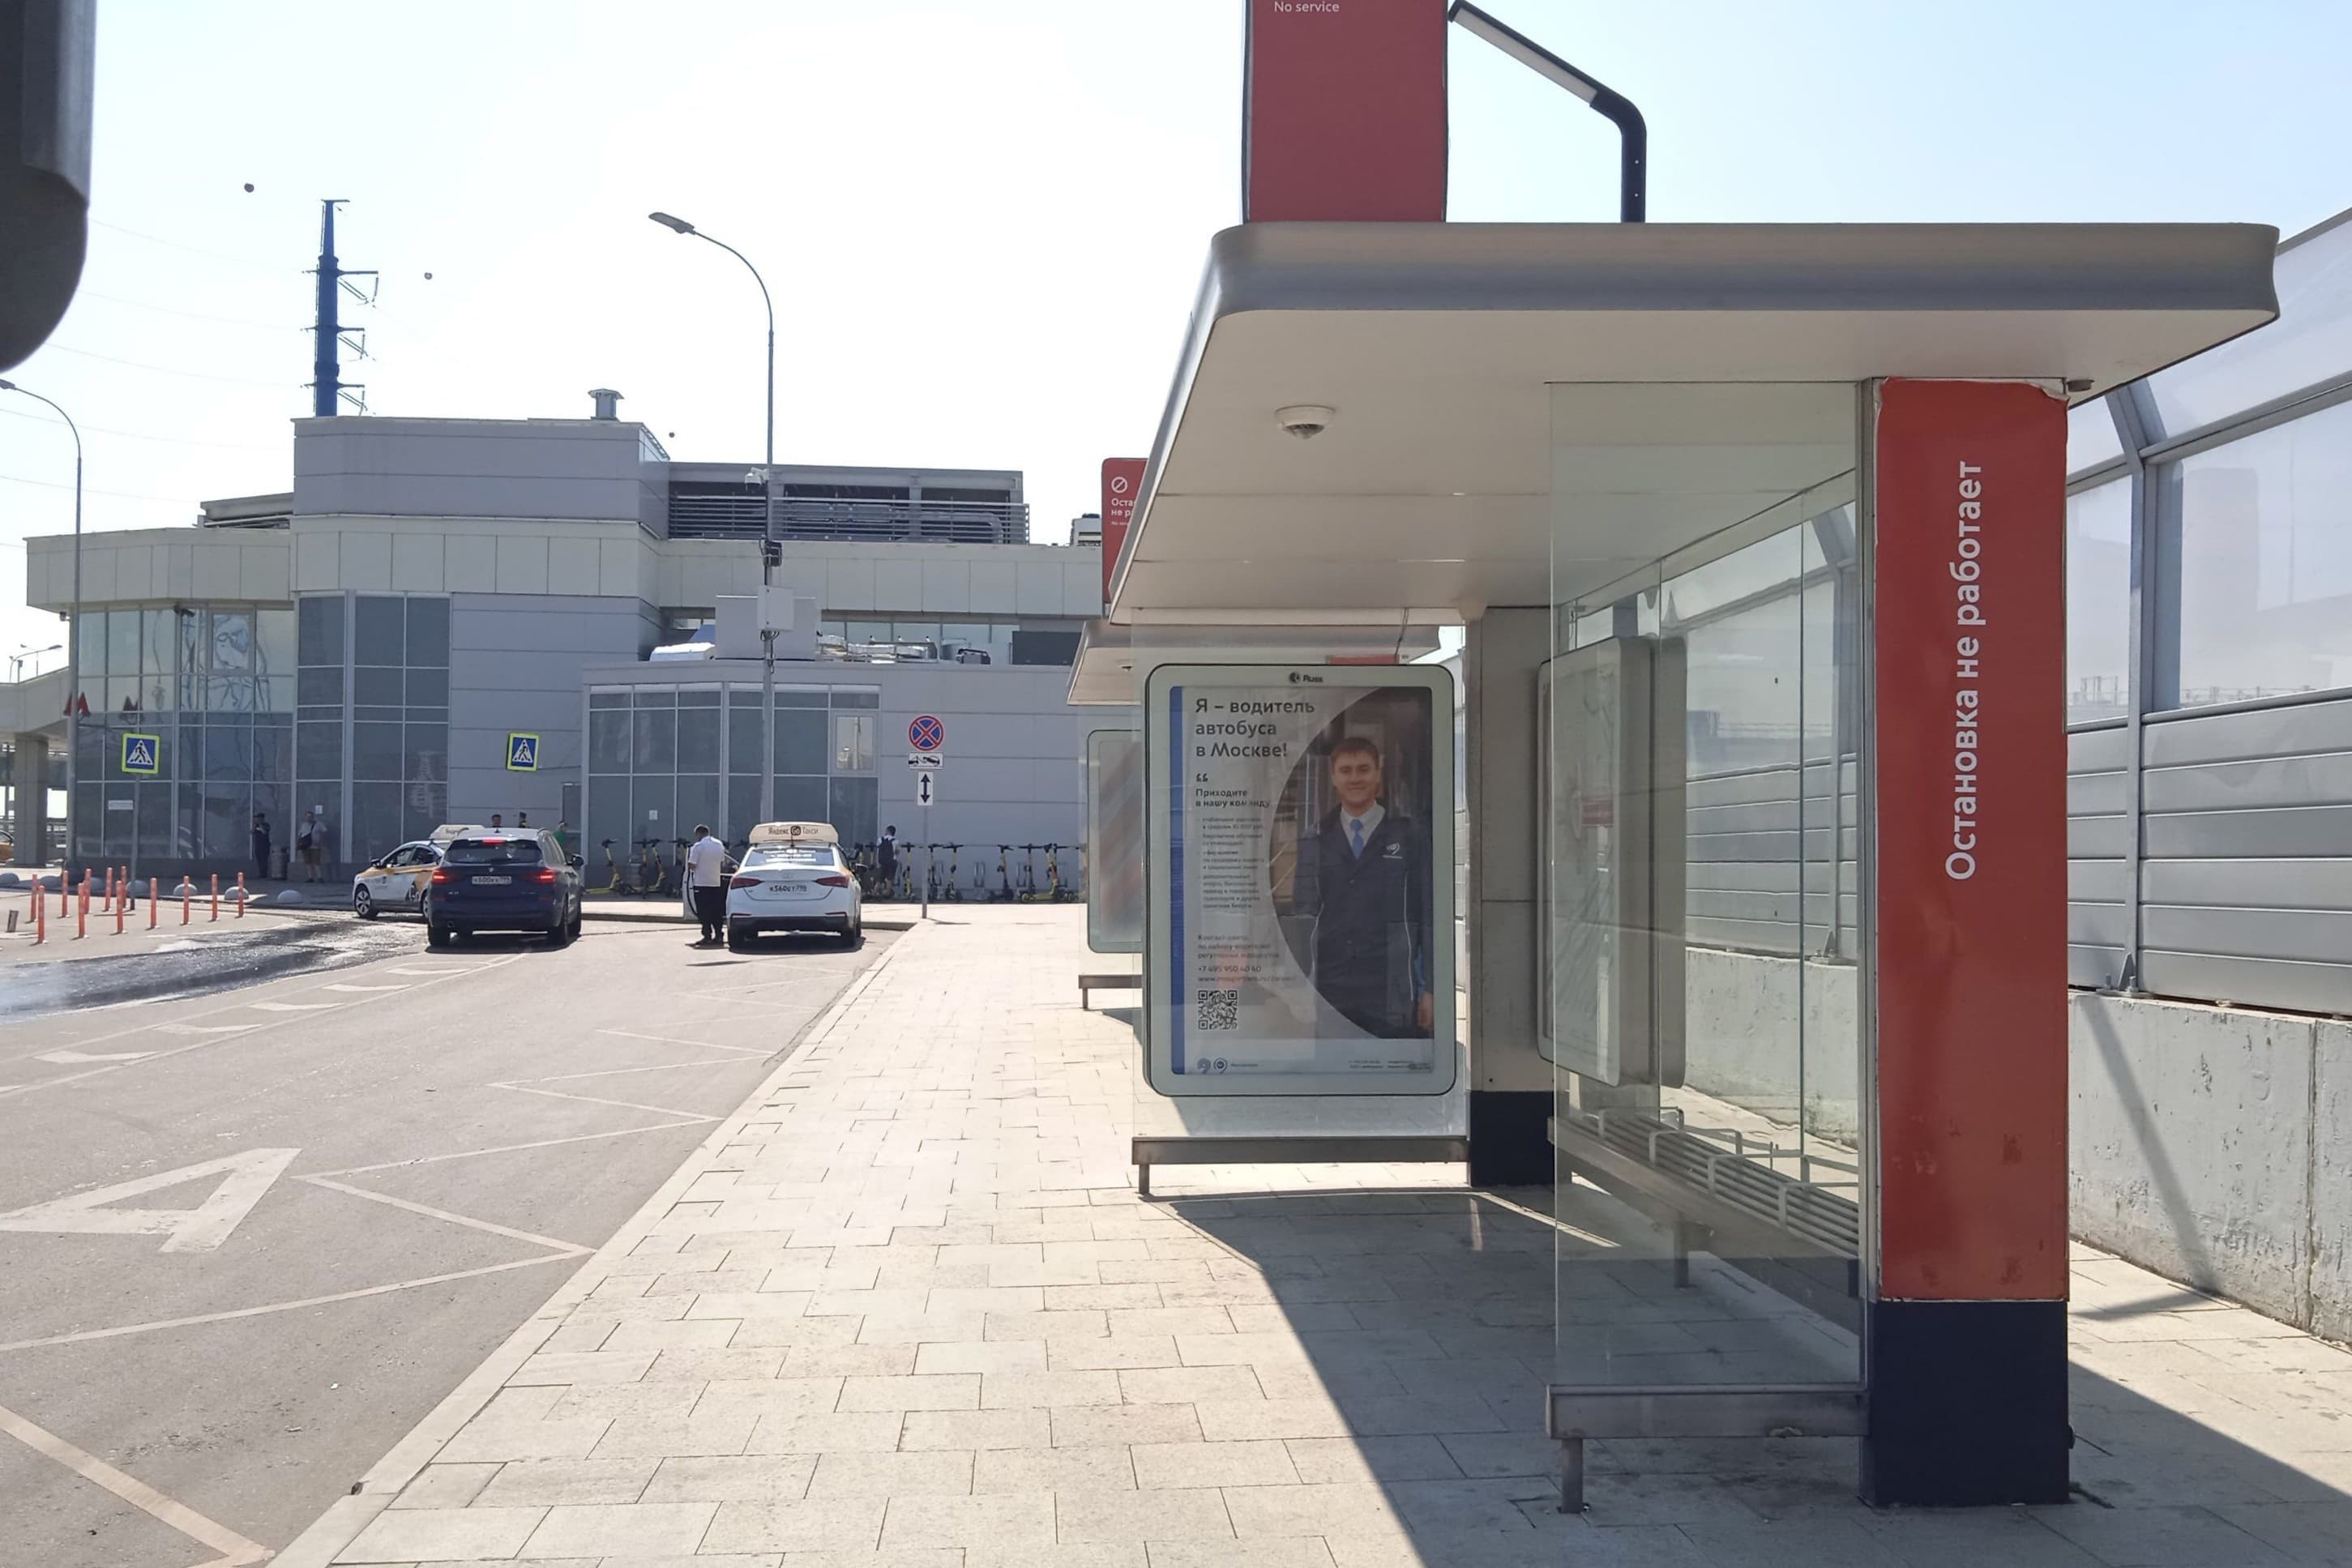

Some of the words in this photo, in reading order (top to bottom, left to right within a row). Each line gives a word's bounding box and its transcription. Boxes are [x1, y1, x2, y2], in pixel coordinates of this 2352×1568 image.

[1274, 2, 1292, 12] No
[1296, 2, 1340, 12] service
[1111, 498, 1135, 506] Оста
[1949, 461, 1986, 626] работает
[1956, 636, 1979, 678] не
[1302, 674, 1324, 683] Russ
[1195, 698, 1208, 713] Я
[1229, 702, 1315, 715] водитель
[1195, 720, 1277, 738] автобуса
[1196, 746, 1205, 757] в
[1211, 741, 1287, 757] Москве!
[1195, 788, 1248, 798] Приходите
[1945, 690, 1978, 880] Остановка
[1204, 800, 1227, 809] нашу
[1229, 800, 1270, 809] комнду
